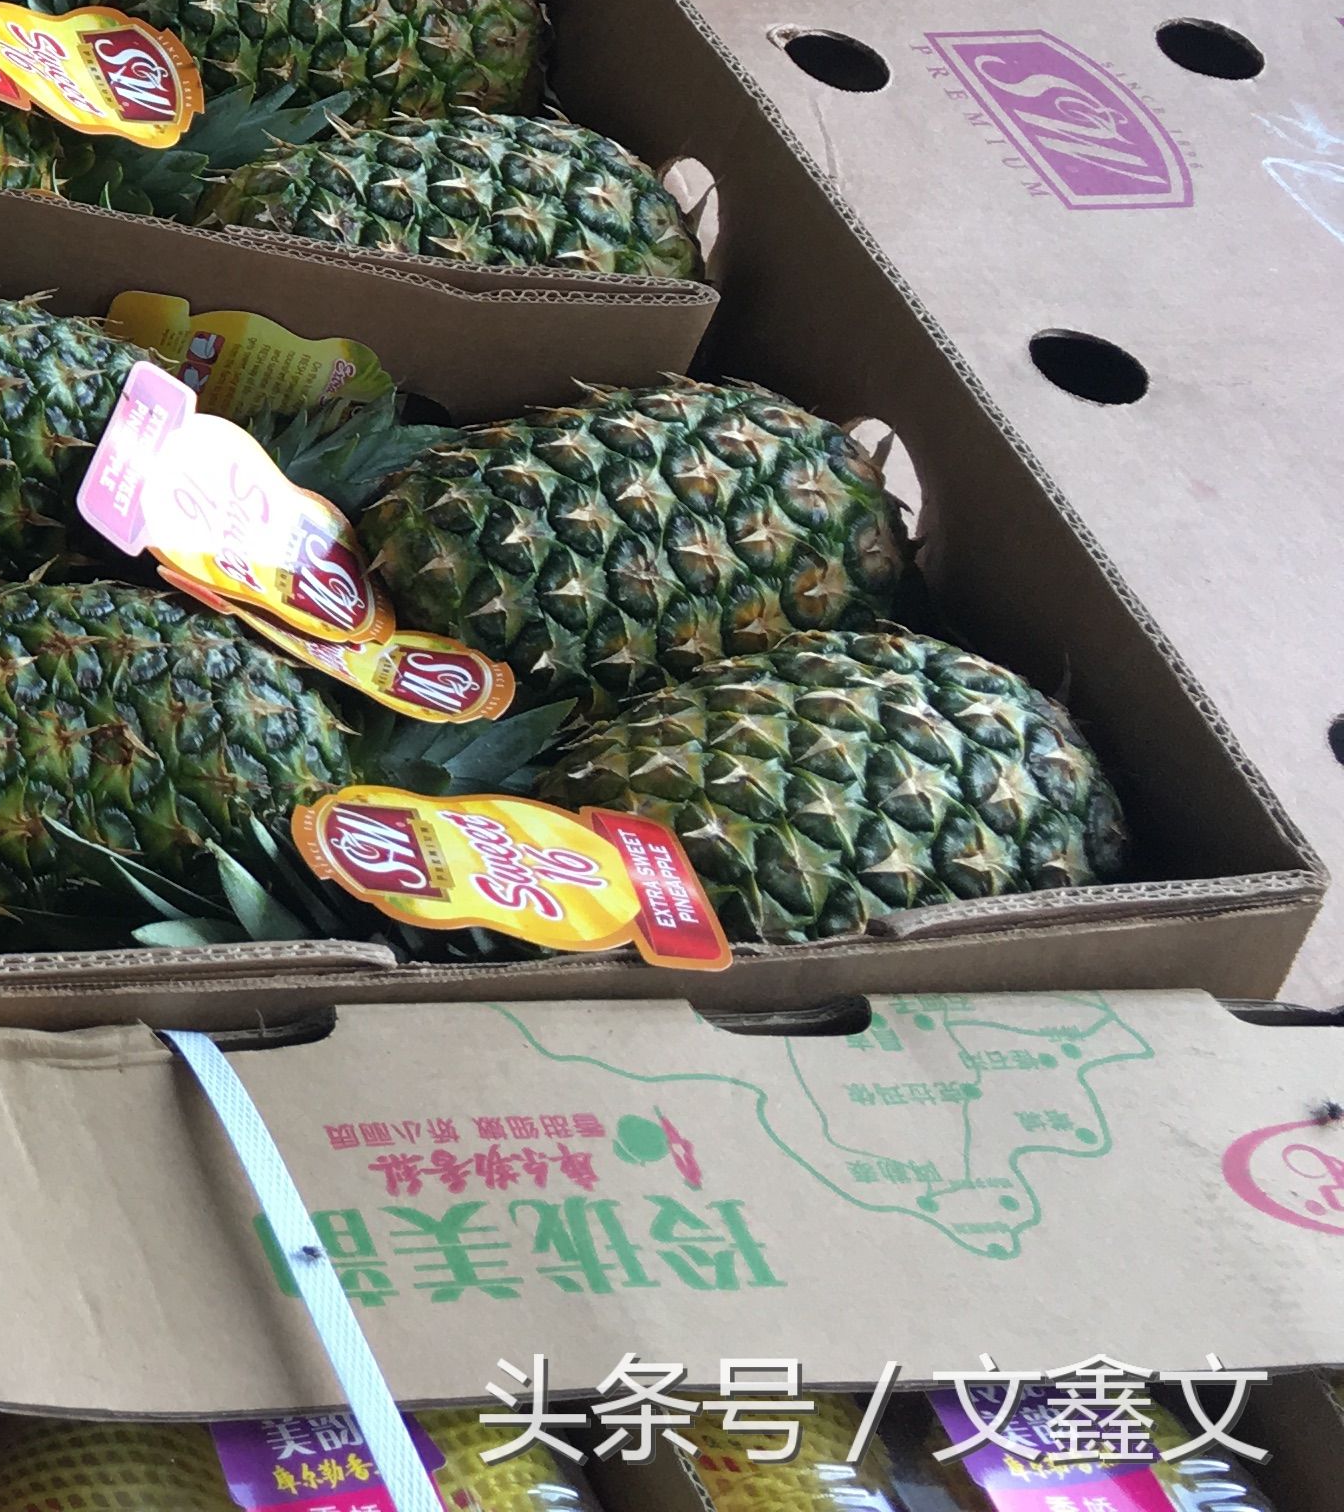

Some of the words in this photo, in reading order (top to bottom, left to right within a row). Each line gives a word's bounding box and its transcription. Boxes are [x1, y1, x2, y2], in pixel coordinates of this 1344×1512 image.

[9, 22, 104, 119] Sweet
[94, 38, 177, 116] S&W
[910, 44, 1054, 198] PREMIUM
[973, 54, 1170, 186] S&W
[328, 805, 431, 890] S&W
[438, 808, 564, 922] Sweet
[528, 842, 610, 890] 16
[616, 828, 652, 875] SWEET
[647, 842, 699, 924] PINEAPPLE
[646, 874, 677, 929] EXTRA
[322, 1116, 460, 1151] 娇小丽质
[472, 1114, 606, 1144] 香甜细嫩
[273, 1452, 381, 1496] 库尔勒香
